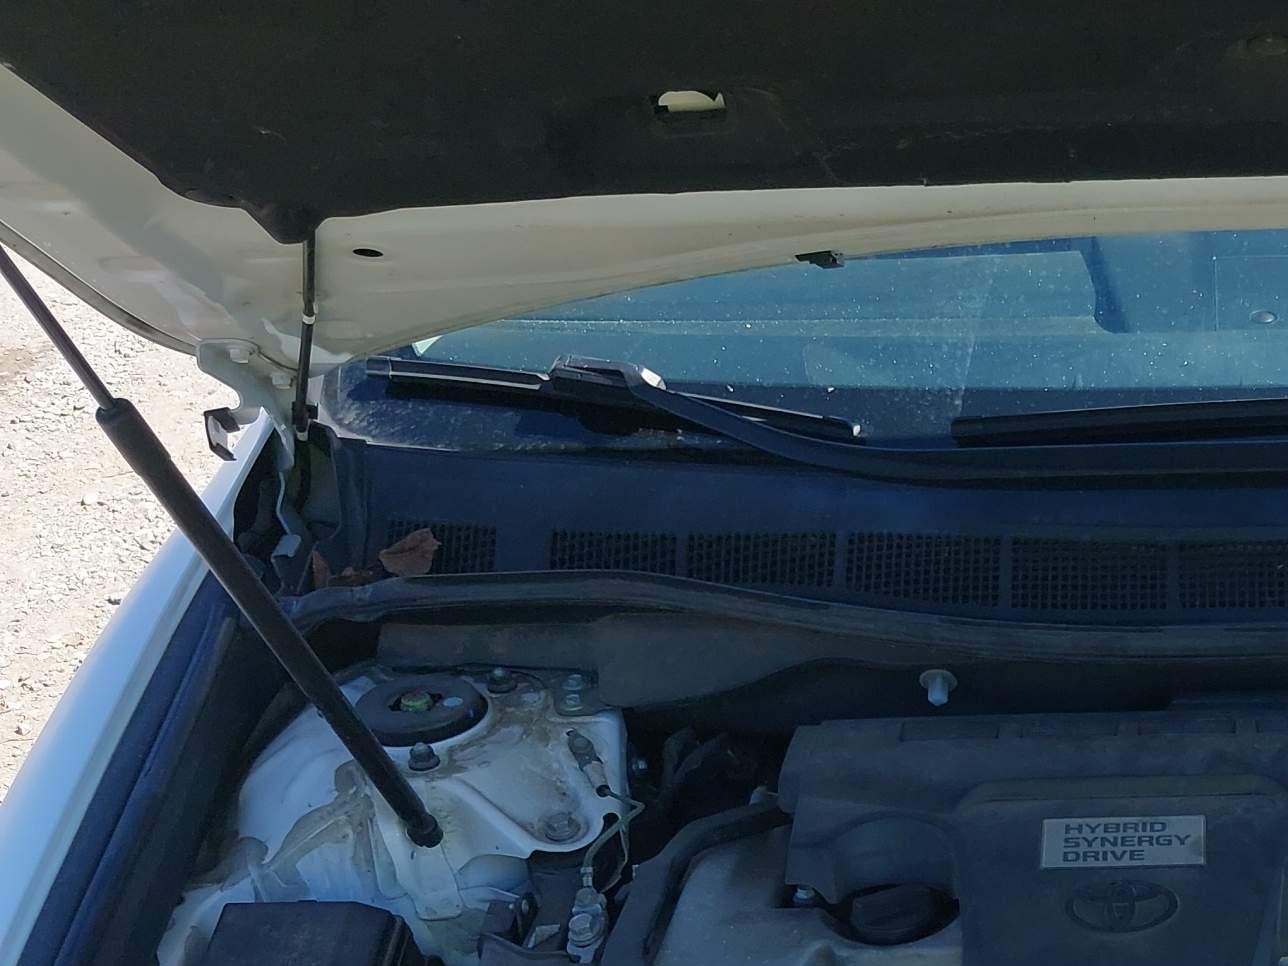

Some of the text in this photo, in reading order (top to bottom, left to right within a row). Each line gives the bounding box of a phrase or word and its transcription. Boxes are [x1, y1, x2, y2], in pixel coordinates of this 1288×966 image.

[1064, 822, 1168, 834] HYBRID
[1063, 834, 1192, 848] SYNERGY
[1063, 850, 1145, 862] DRIVE
